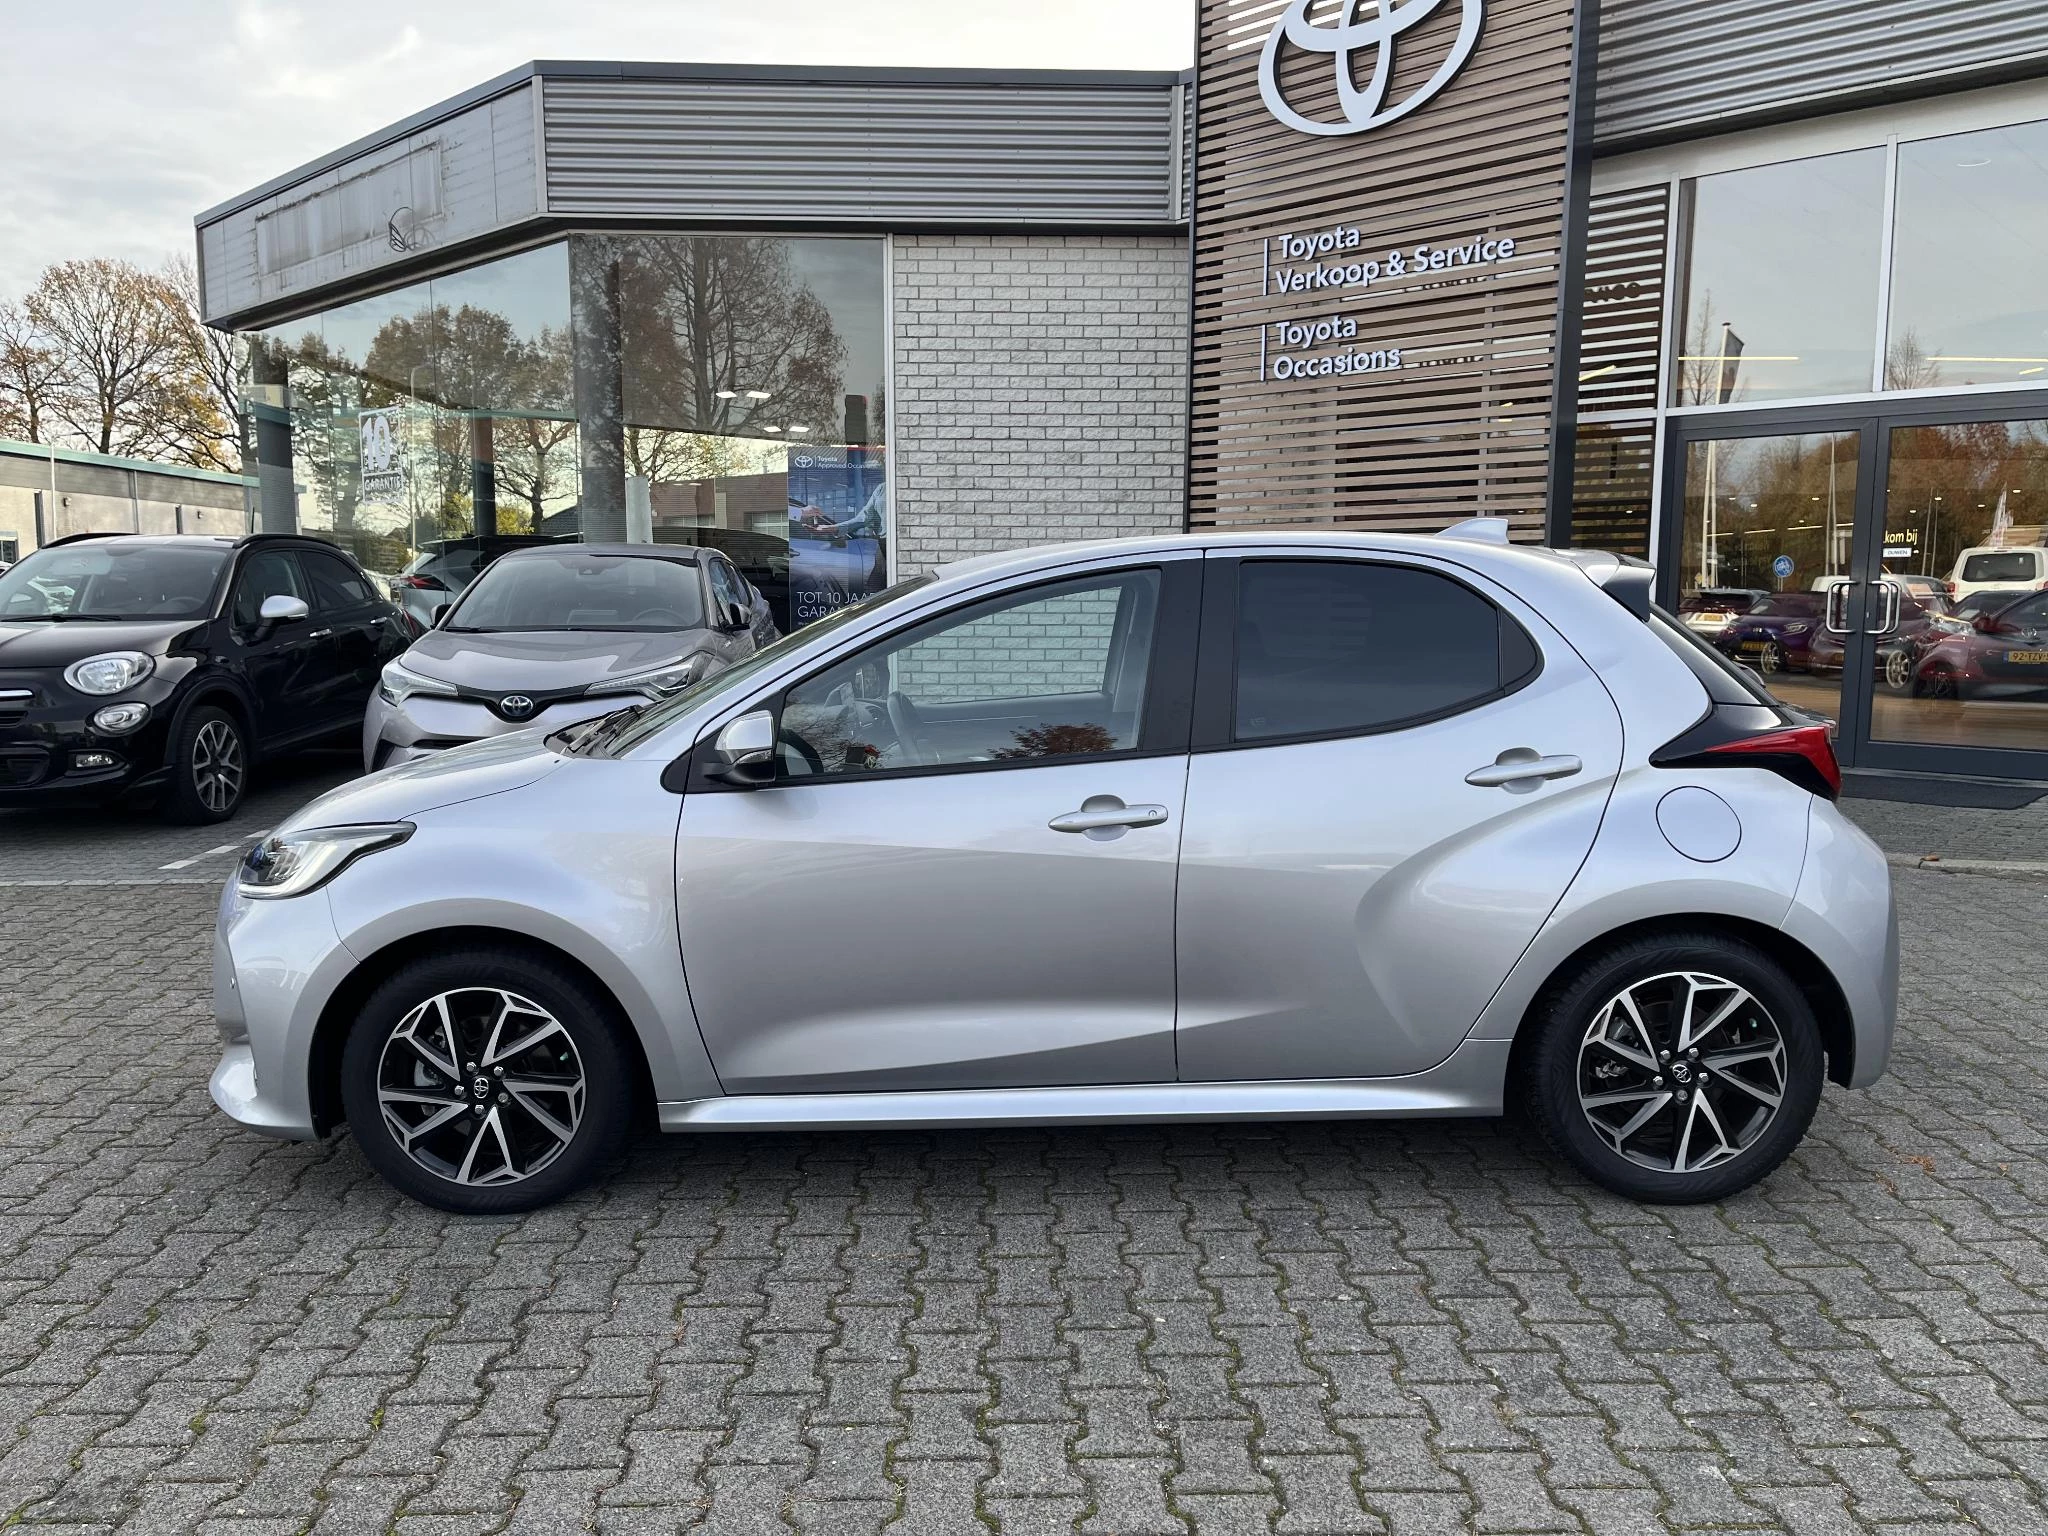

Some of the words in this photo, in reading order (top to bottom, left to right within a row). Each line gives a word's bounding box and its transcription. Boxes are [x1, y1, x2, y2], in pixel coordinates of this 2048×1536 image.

[1278, 226, 1361, 261] Toyota
[1276, 259, 1380, 294] Verkoop
[1386, 251, 1406, 277] &
[1414, 236, 1515, 272] Service
[1276, 315, 1357, 349] Toyota
[1273, 347, 1401, 380] Occasions
[362, 415, 390, 470] 10
[1883, 530, 1904, 543] kom
[1906, 529, 1918, 545] bij
[797, 592, 823, 604] TOT
[827, 592, 840, 604] 10
[797, 605, 841, 618] GARA
